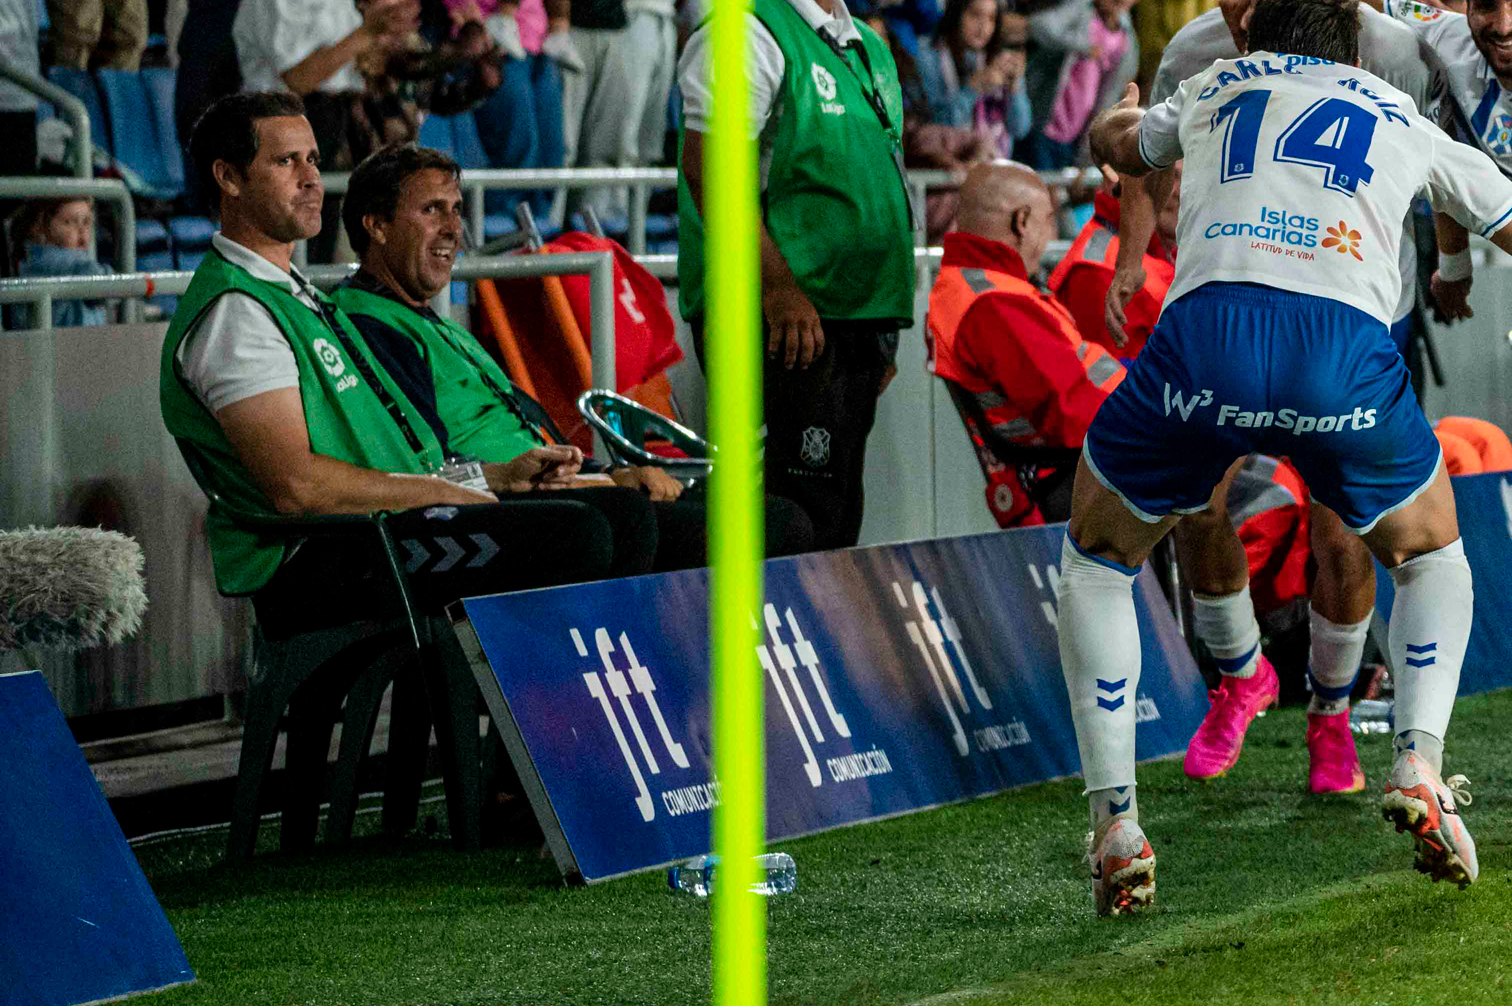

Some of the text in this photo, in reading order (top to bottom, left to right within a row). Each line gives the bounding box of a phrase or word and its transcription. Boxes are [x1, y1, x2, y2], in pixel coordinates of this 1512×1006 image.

[1209, 89, 1379, 199] 14
[1260, 206, 1320, 232] Islas
[1204, 221, 1319, 249] Canarias
[1250, 241, 1316, 262] LATITUD DE VIDA
[1216, 404, 1378, 436] FanSports
[825, 743, 893, 783] COMUNICACIÓN
